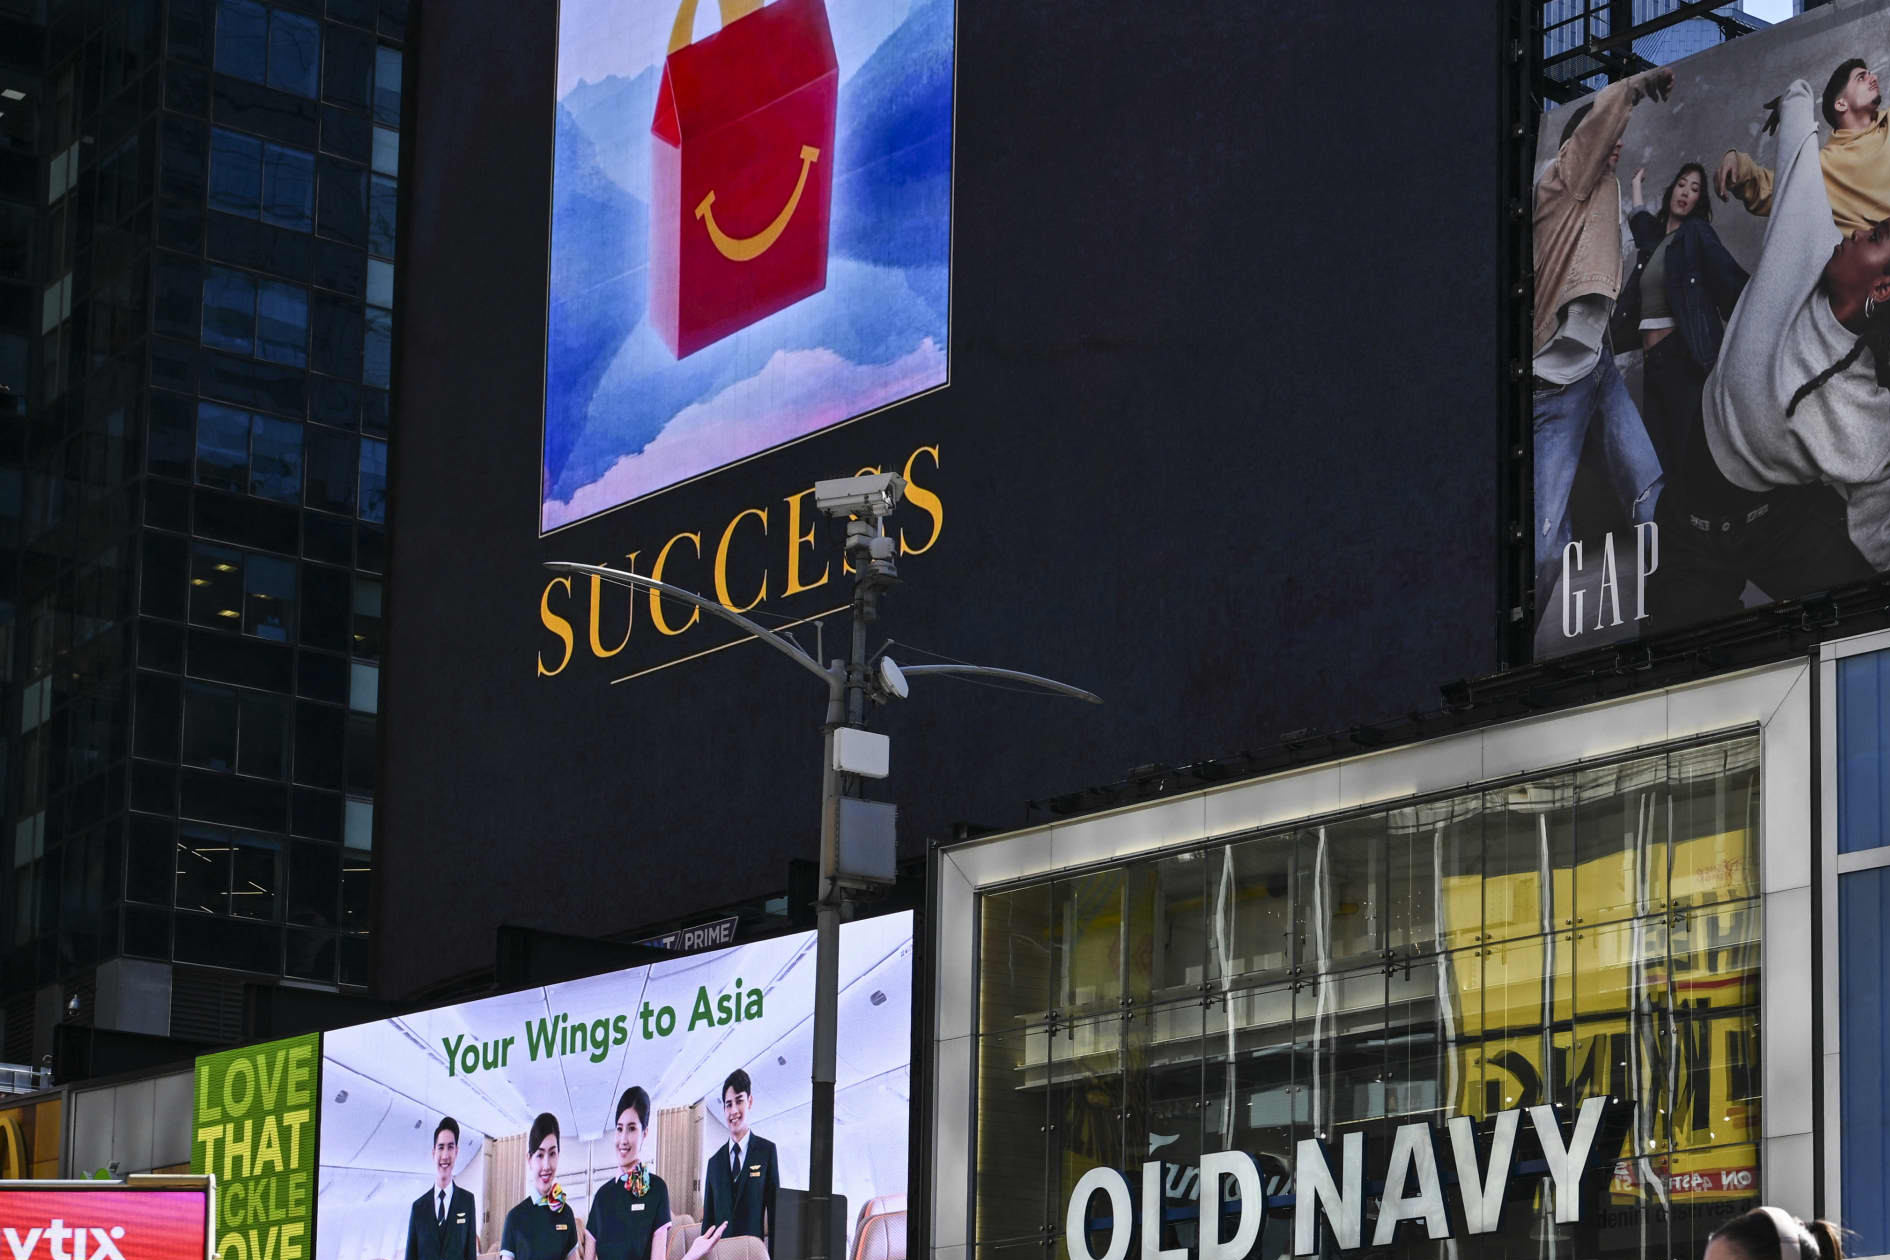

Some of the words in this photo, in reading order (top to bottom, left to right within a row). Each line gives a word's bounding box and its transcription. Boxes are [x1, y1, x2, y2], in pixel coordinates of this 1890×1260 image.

[537, 444, 944, 678] SUCCES
[1562, 521, 1659, 638] GAP
[684, 923, 731, 951] PRIME
[442, 1034, 515, 1077] Your
[525, 1013, 628, 1064] Wings
[640, 1001, 677, 1040] to
[688, 978, 764, 1032] Asia
[199, 1044, 313, 1123] LOVE
[197, 1109, 310, 1181] THAT
[1294, 1095, 1608, 1256] NAVY
